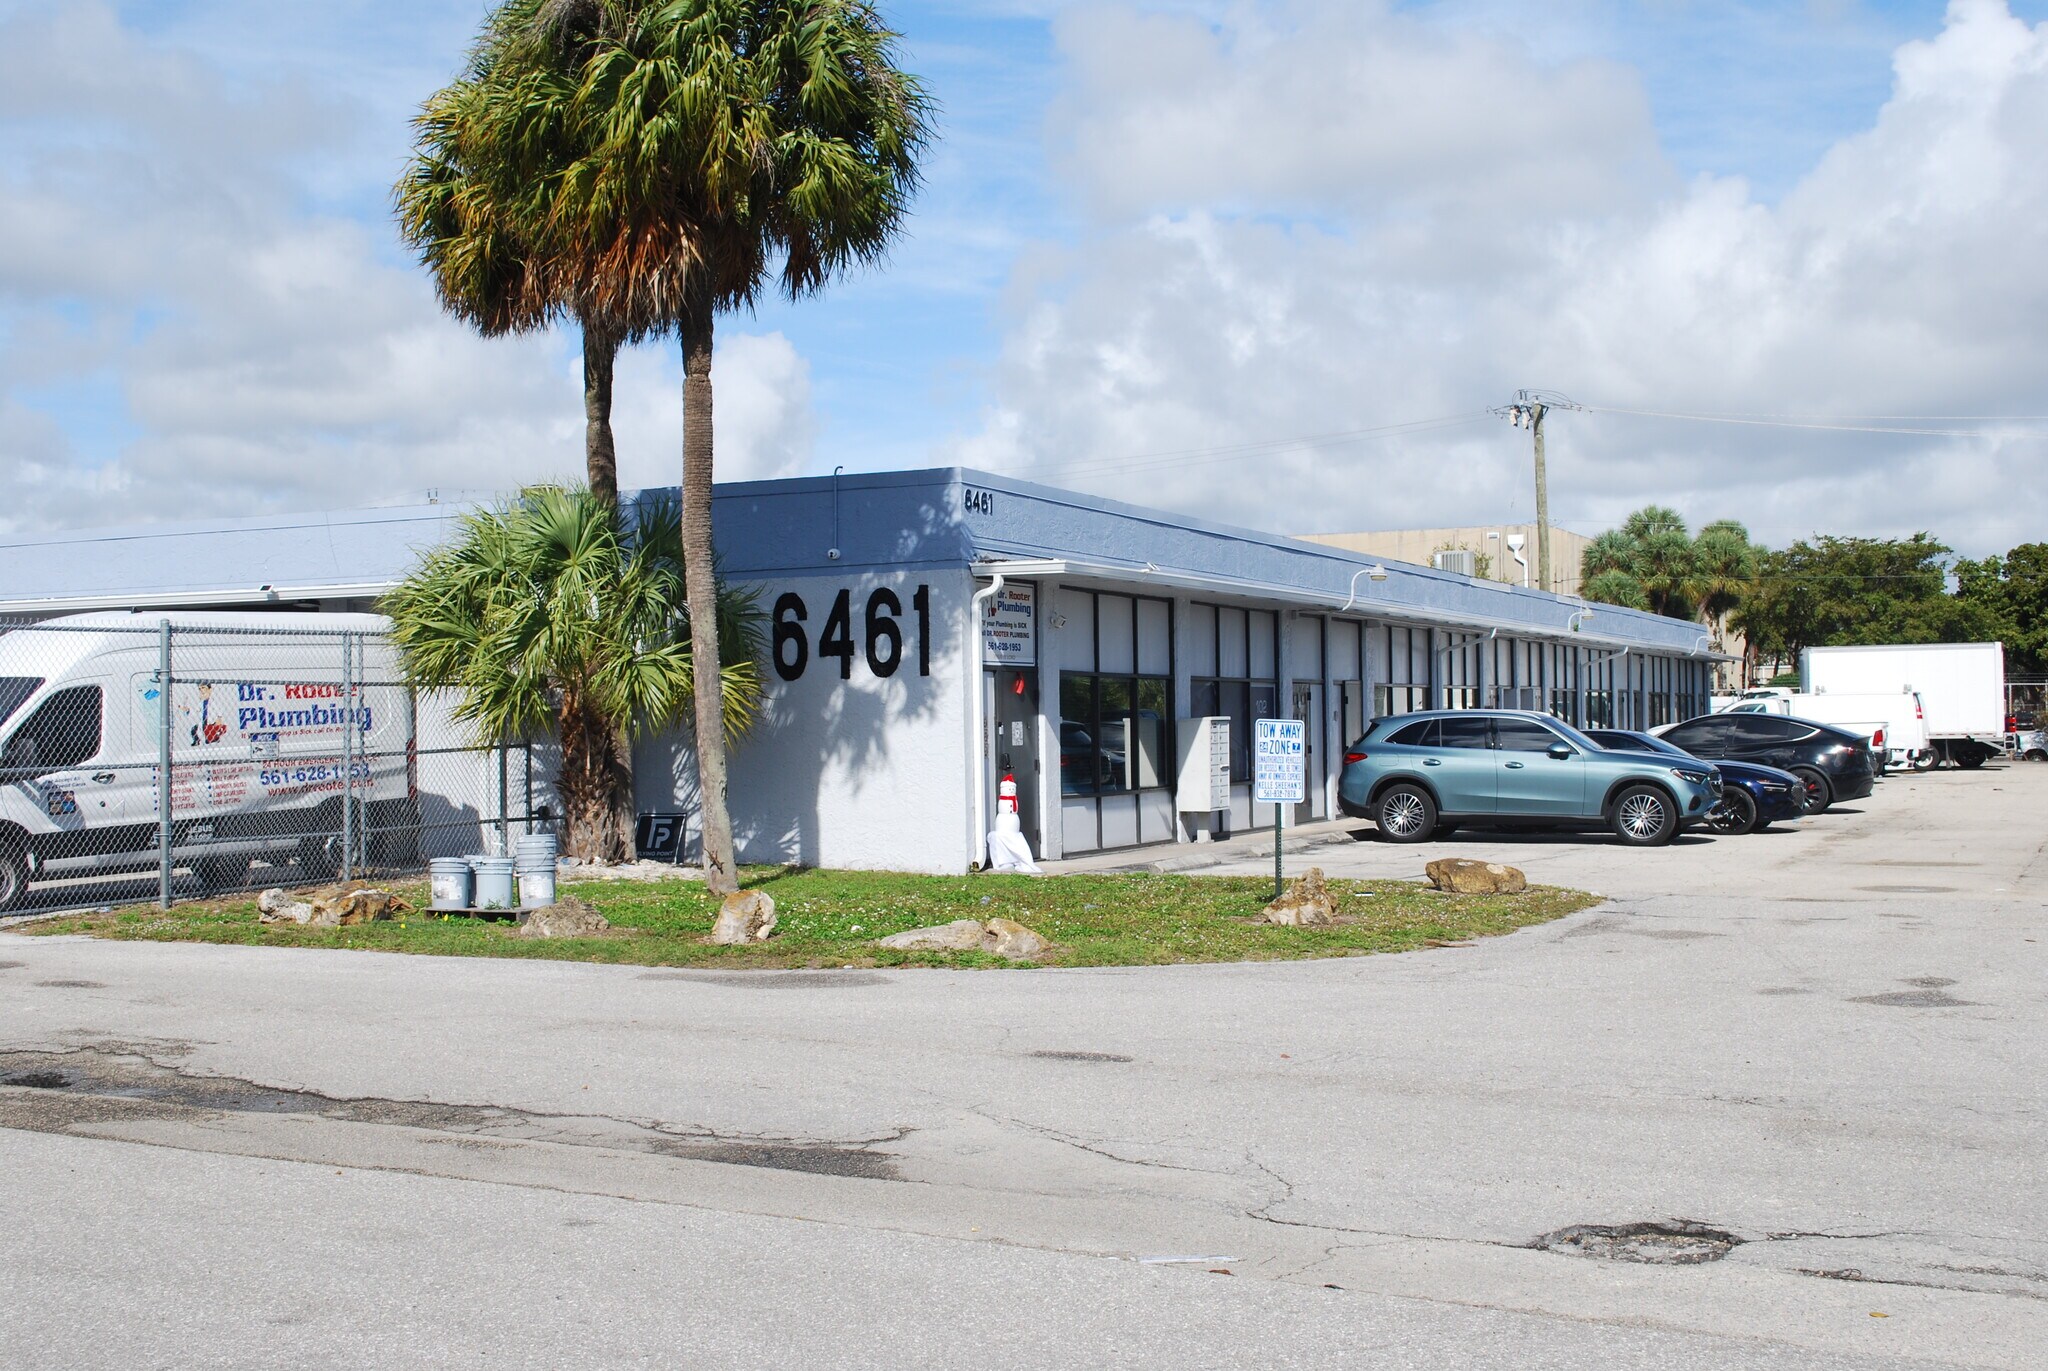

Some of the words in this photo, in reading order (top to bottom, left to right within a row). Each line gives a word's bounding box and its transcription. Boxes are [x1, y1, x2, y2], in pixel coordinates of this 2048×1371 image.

[964, 489, 993, 516] 6461
[1009, 591, 1030, 601] Rooter
[998, 601, 1031, 617] Plumbing
[773, 584, 930, 681] 6461
[996, 621, 1013, 629] Plumbing
[238, 682, 275, 701] Dr.
[1256, 700, 1267, 713] 102
[239, 703, 372, 731] Plumbing
[1259, 723, 1276, 738] TOW
[1280, 724, 1302, 739] AWAY
[1269, 740, 1291, 755] ZONE
[274, 758, 297, 768] HOUR
[299, 757, 346, 766] EMERGENC
[260, 763, 370, 786] 561-628-153
